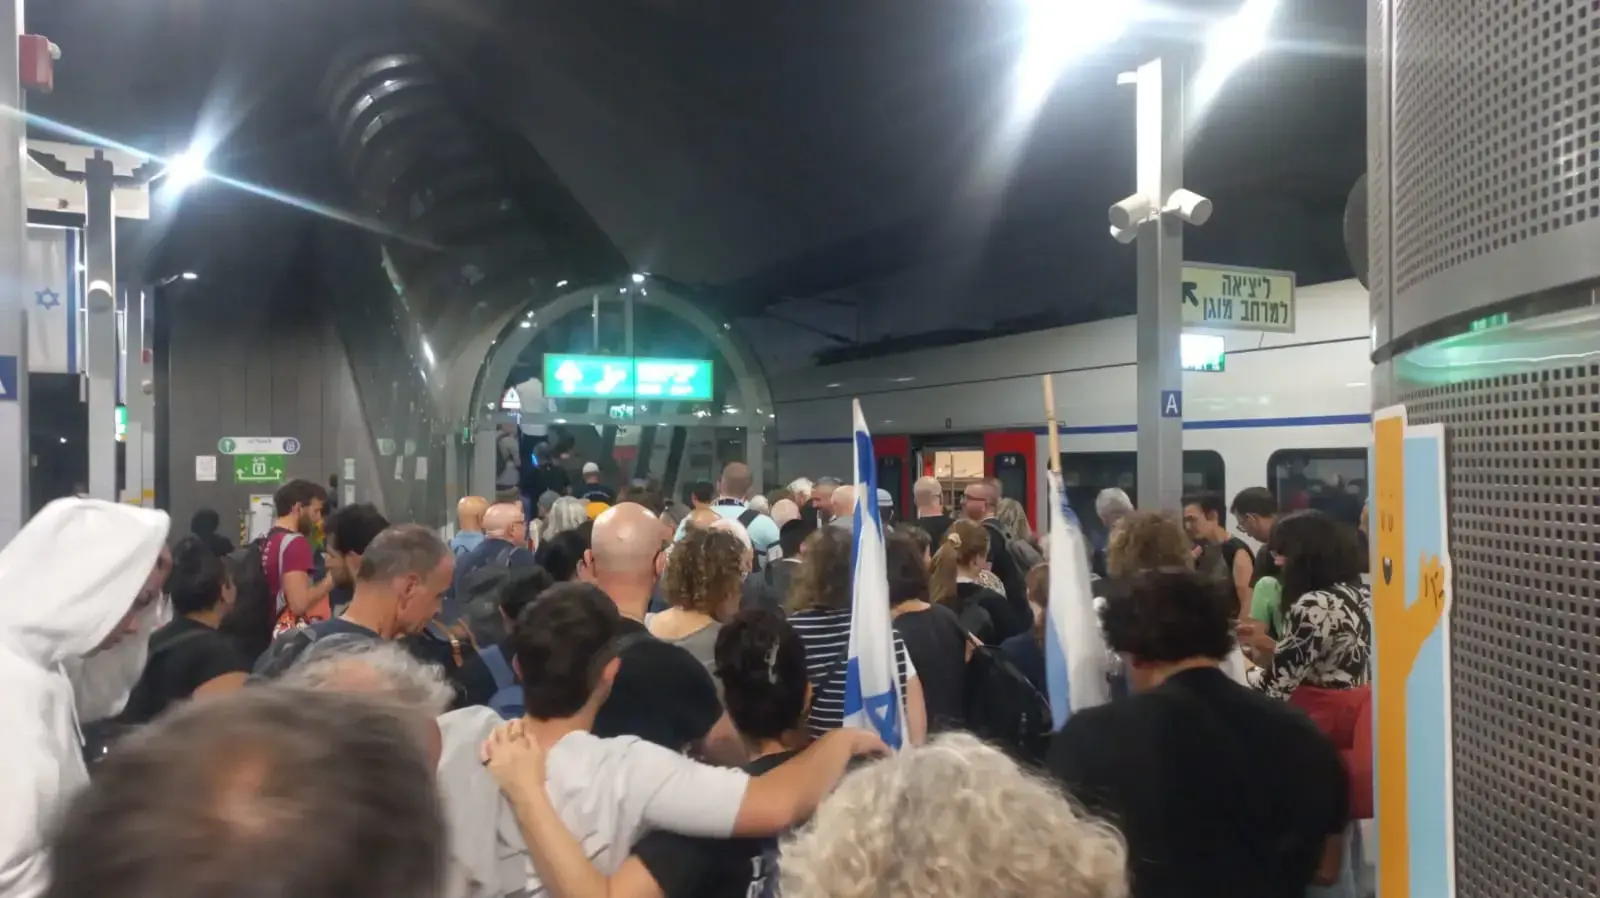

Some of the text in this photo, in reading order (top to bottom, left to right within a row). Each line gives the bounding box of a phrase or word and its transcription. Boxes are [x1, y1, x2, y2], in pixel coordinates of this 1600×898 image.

[1222, 274, 1271, 299] ליציאה
[1203, 297, 1288, 324] למרחב מוגן
[1166, 393, 1178, 414] A
